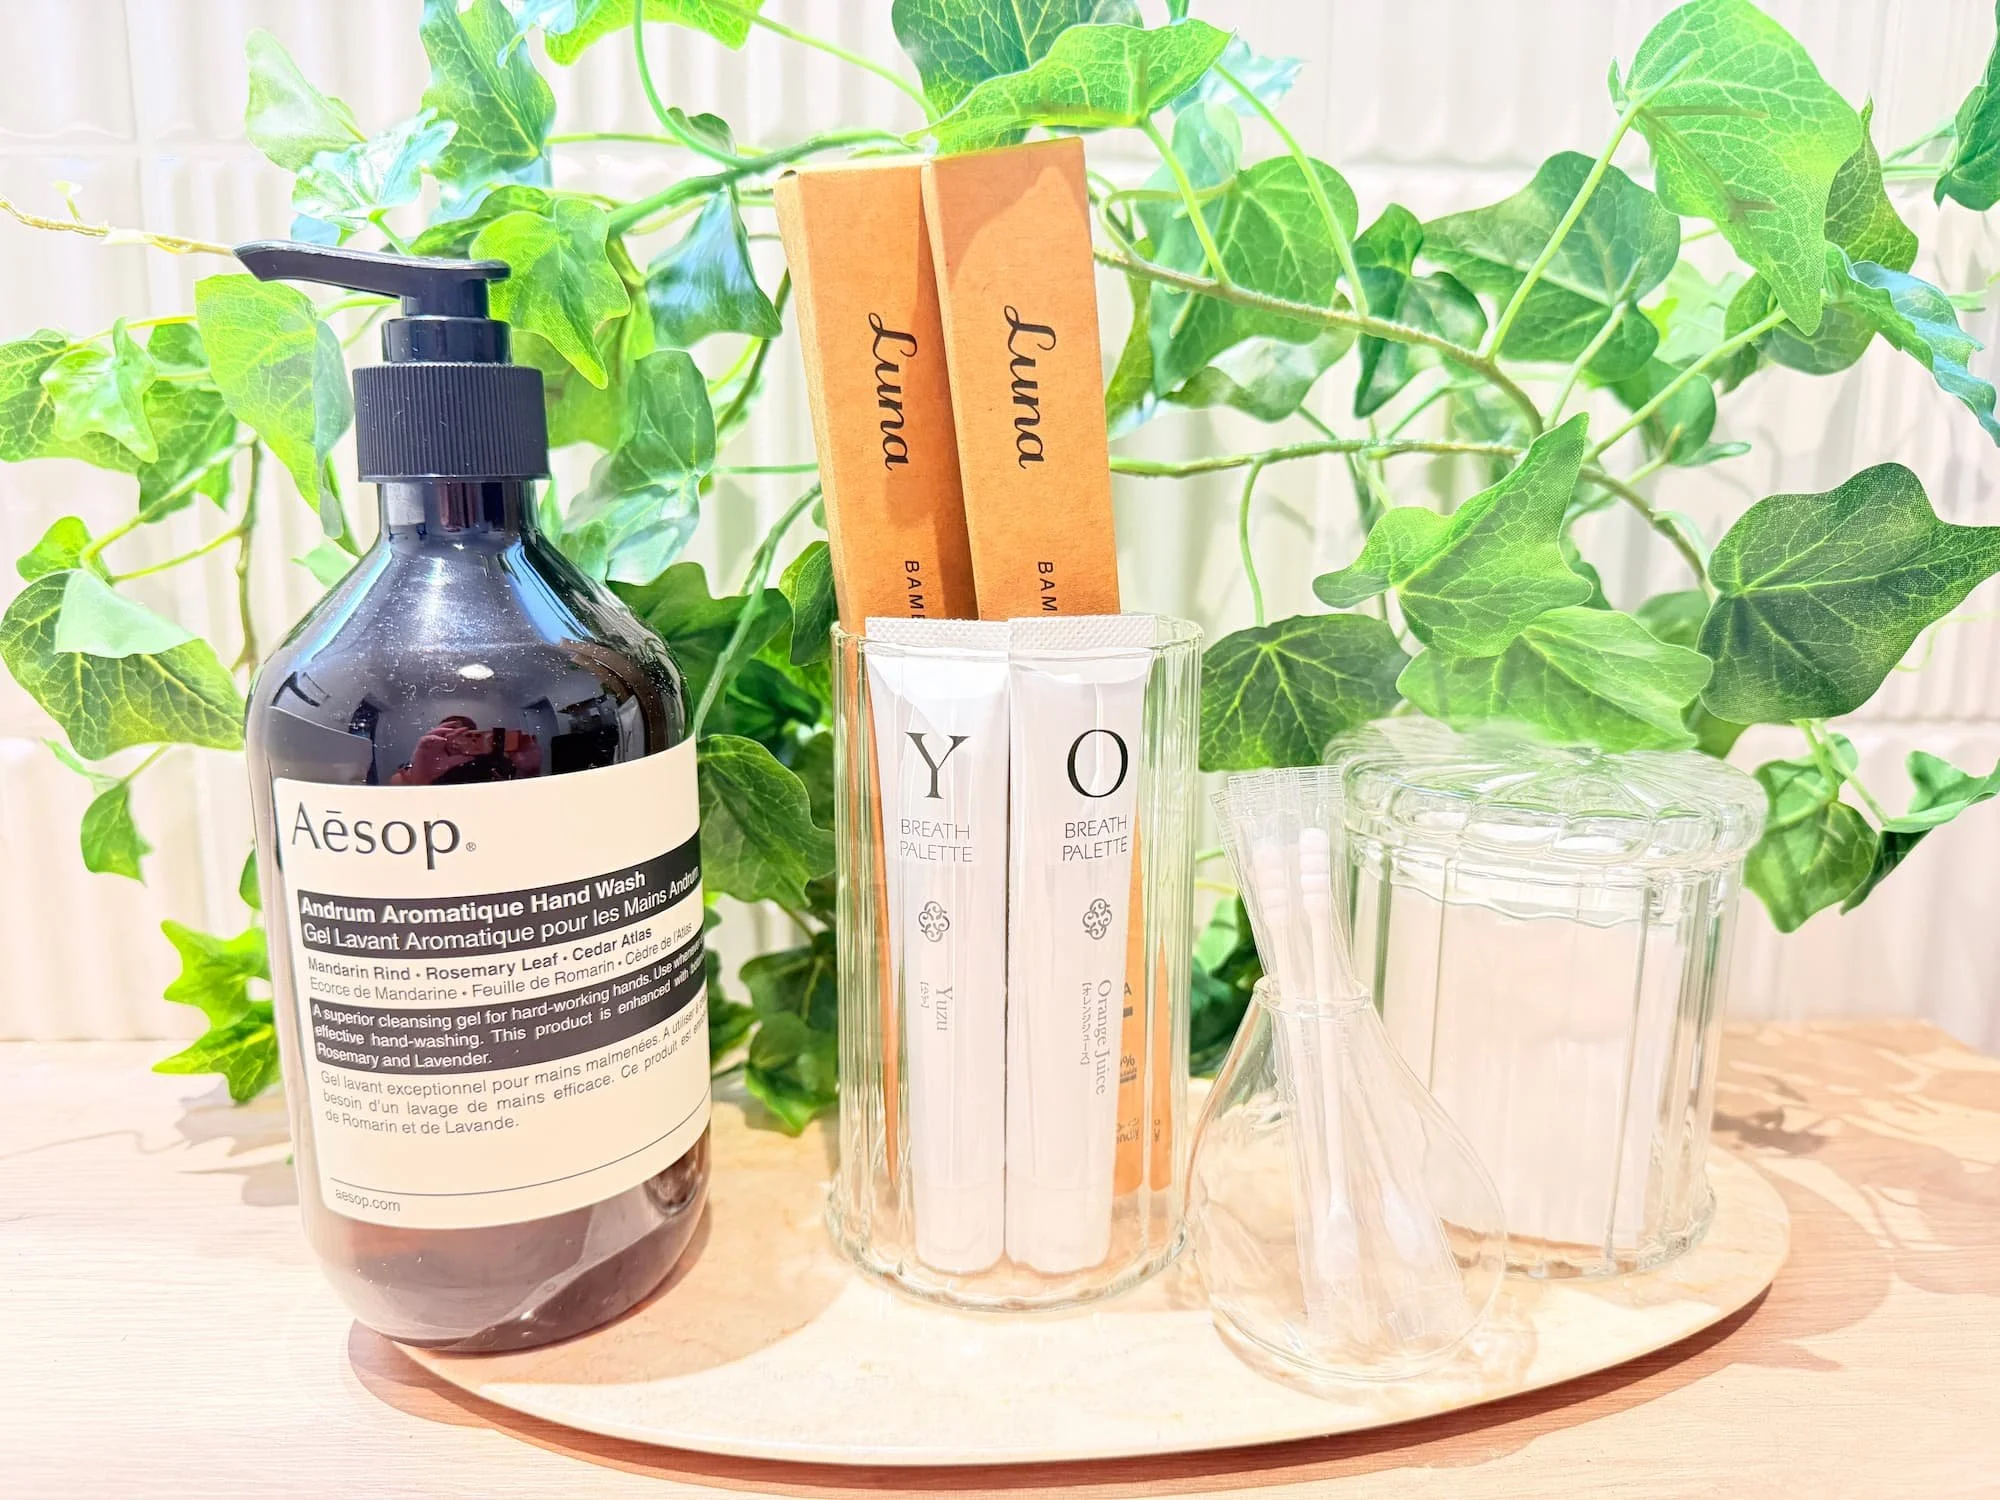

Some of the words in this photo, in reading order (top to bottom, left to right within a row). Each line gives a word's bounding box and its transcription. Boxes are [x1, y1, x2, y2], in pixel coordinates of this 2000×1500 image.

[869, 312, 918, 471] Luna
[1004, 305, 1057, 470] Luna
[904, 560, 926, 619] BAM
[904, 731, 971, 800] Y
[1066, 729, 1129, 798] O
[899, 840, 973, 863] PALETTE
[900, 818, 970, 840] BREATH
[1062, 836, 1128, 862] PALETTE
[1064, 814, 1128, 839] BREATH
[300, 896, 376, 923] Andrum
[382, 900, 524, 925] Aromatique
[530, 884, 591, 914] Hand
[595, 870, 646, 900] Wash
[304, 922, 331, 945] Gel
[335, 927, 400, 950] Lavant
[405, 924, 535, 950] Aromatique
[541, 914, 588, 942] pour
[593, 908, 620, 927] les
[624, 891, 667, 918] Mains
[308, 956, 370, 979] Mandarin
[373, 966, 410, 980] Rind
[426, 962, 516, 980] Rosemary
[522, 954, 558, 971] Leaf
[572, 940, 618, 961] Cedar
[621, 927, 652, 947] Atlas
[310, 976, 350, 996] Ecorce
[354, 983, 371, 998] de
[375, 986, 457, 1001] Mandarine
[472, 975, 525, 998] Feuille
[530, 976, 550, 990] de
[554, 960, 615, 985] Romarin
[625, 943, 658, 966] Cèdre
[660, 936, 672, 950] de
[313, 1003, 322, 1018] A
[323, 1007, 375, 1027] superior
[378, 1012, 452, 1031] cleansing
[456, 1011, 481, 1030] gel
[485, 1008, 507, 1024] for
[511, 988, 610, 1020] hard-working
[612, 974, 652, 997] hands.
[653, 964, 673, 980] Use
[315, 1025, 365, 1045] effective
[371, 1032, 484, 1049] hand-washing.
[491, 1027, 526, 1044] This
[535, 1012, 593, 1039] product
[600, 1006, 612, 1020] is
[618, 979, 671, 1014] enhanced
[936, 986, 953, 1032] Yuzu
[1093, 979, 1112, 1047] Orange
[317, 1042, 379, 1069] Rosemary
[383, 1053, 411, 1068] and
[415, 1052, 493, 1068] Lavender.
[321, 1070, 340, 1086] Gel
[344, 1074, 383, 1094] lavant
[387, 1079, 487, 1099] exceptionnel
[492, 1075, 529, 1094] pour
[535, 1063, 581, 1085] mains
[586, 1035, 661, 1072] malmenées.
[324, 1089, 362, 1111] besoin
[369, 1099, 400, 1114] d'un
[407, 1101, 459, 1118] lavage
[467, 1099, 488, 1114] de
[497, 1091, 545, 1109] mains
[553, 1073, 615, 1101] efficace.
[621, 1063, 639, 1080] Ce
[644, 1040, 678, 1072] produit
[1094, 1048, 1110, 1095] Juice
[325, 1108, 340, 1123] de
[342, 1113, 398, 1134] Romarin
[402, 1121, 416, 1134] et
[420, 1120, 440, 1135] de
[445, 1115, 520, 1135] Lavande.
[335, 1188, 401, 1212] aesop.com
